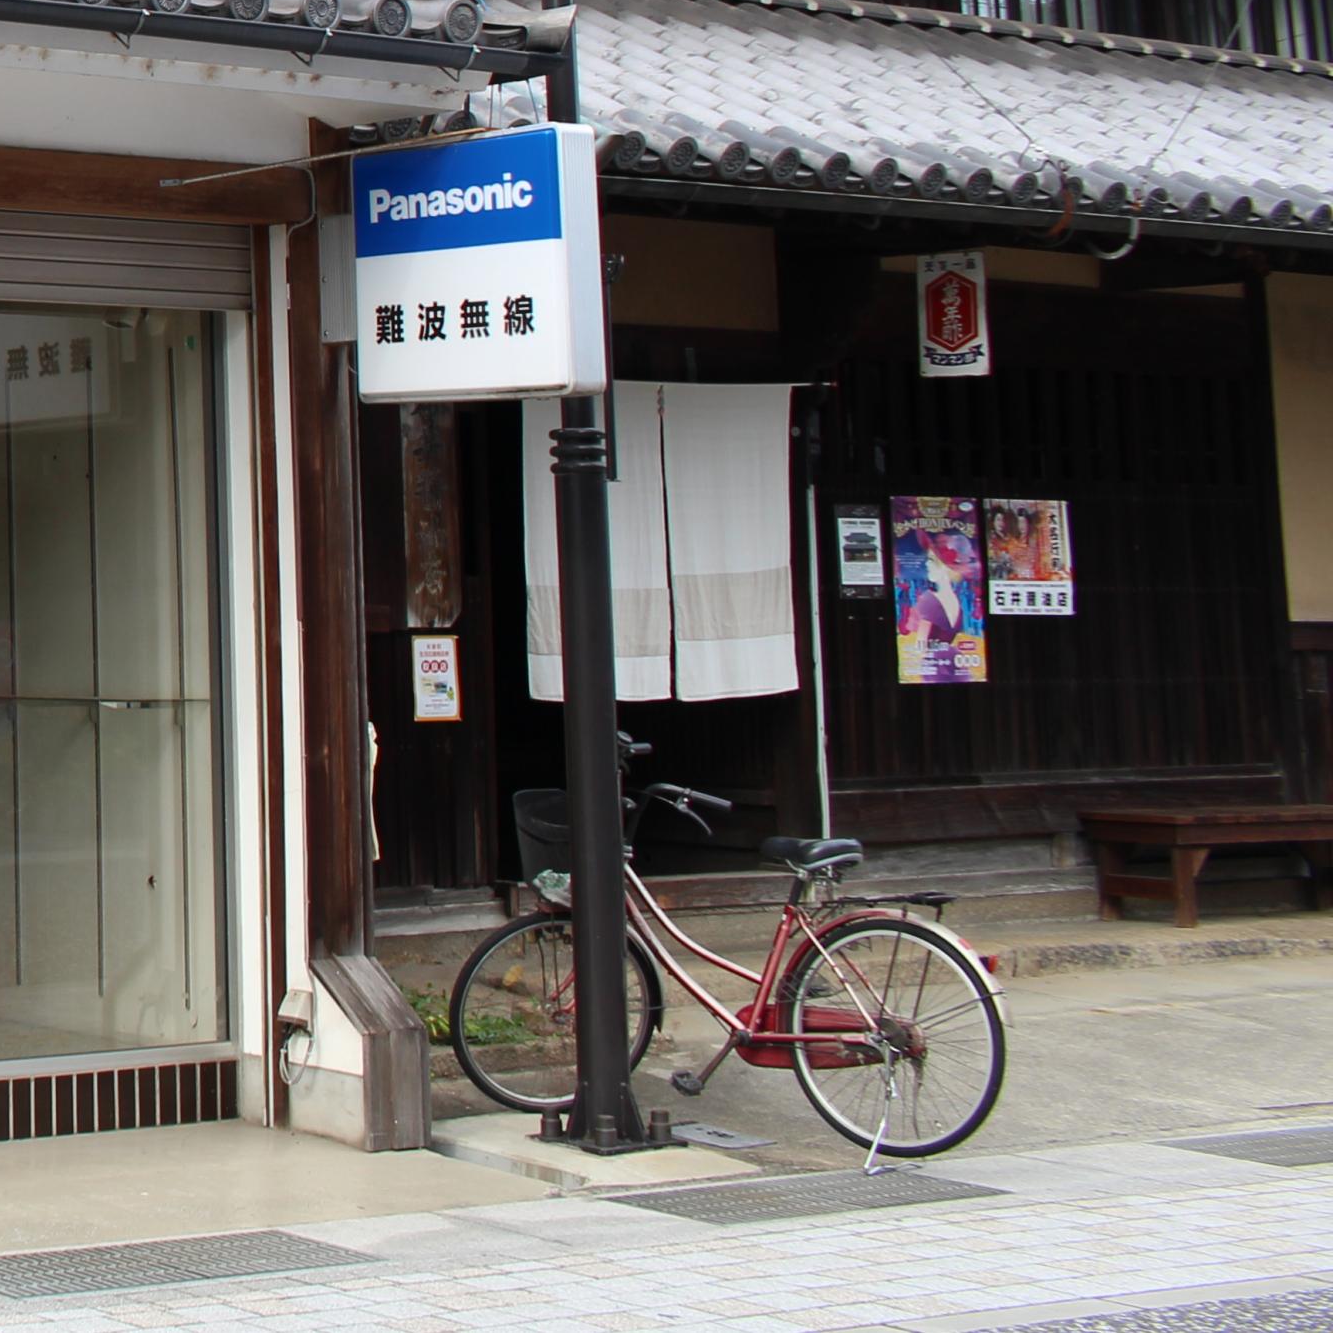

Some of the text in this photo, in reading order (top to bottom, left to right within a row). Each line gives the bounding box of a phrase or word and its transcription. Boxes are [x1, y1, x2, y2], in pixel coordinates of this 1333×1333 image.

[368, 172, 534, 224] Panasonic
[375, 295, 536, 345] 難波無線
